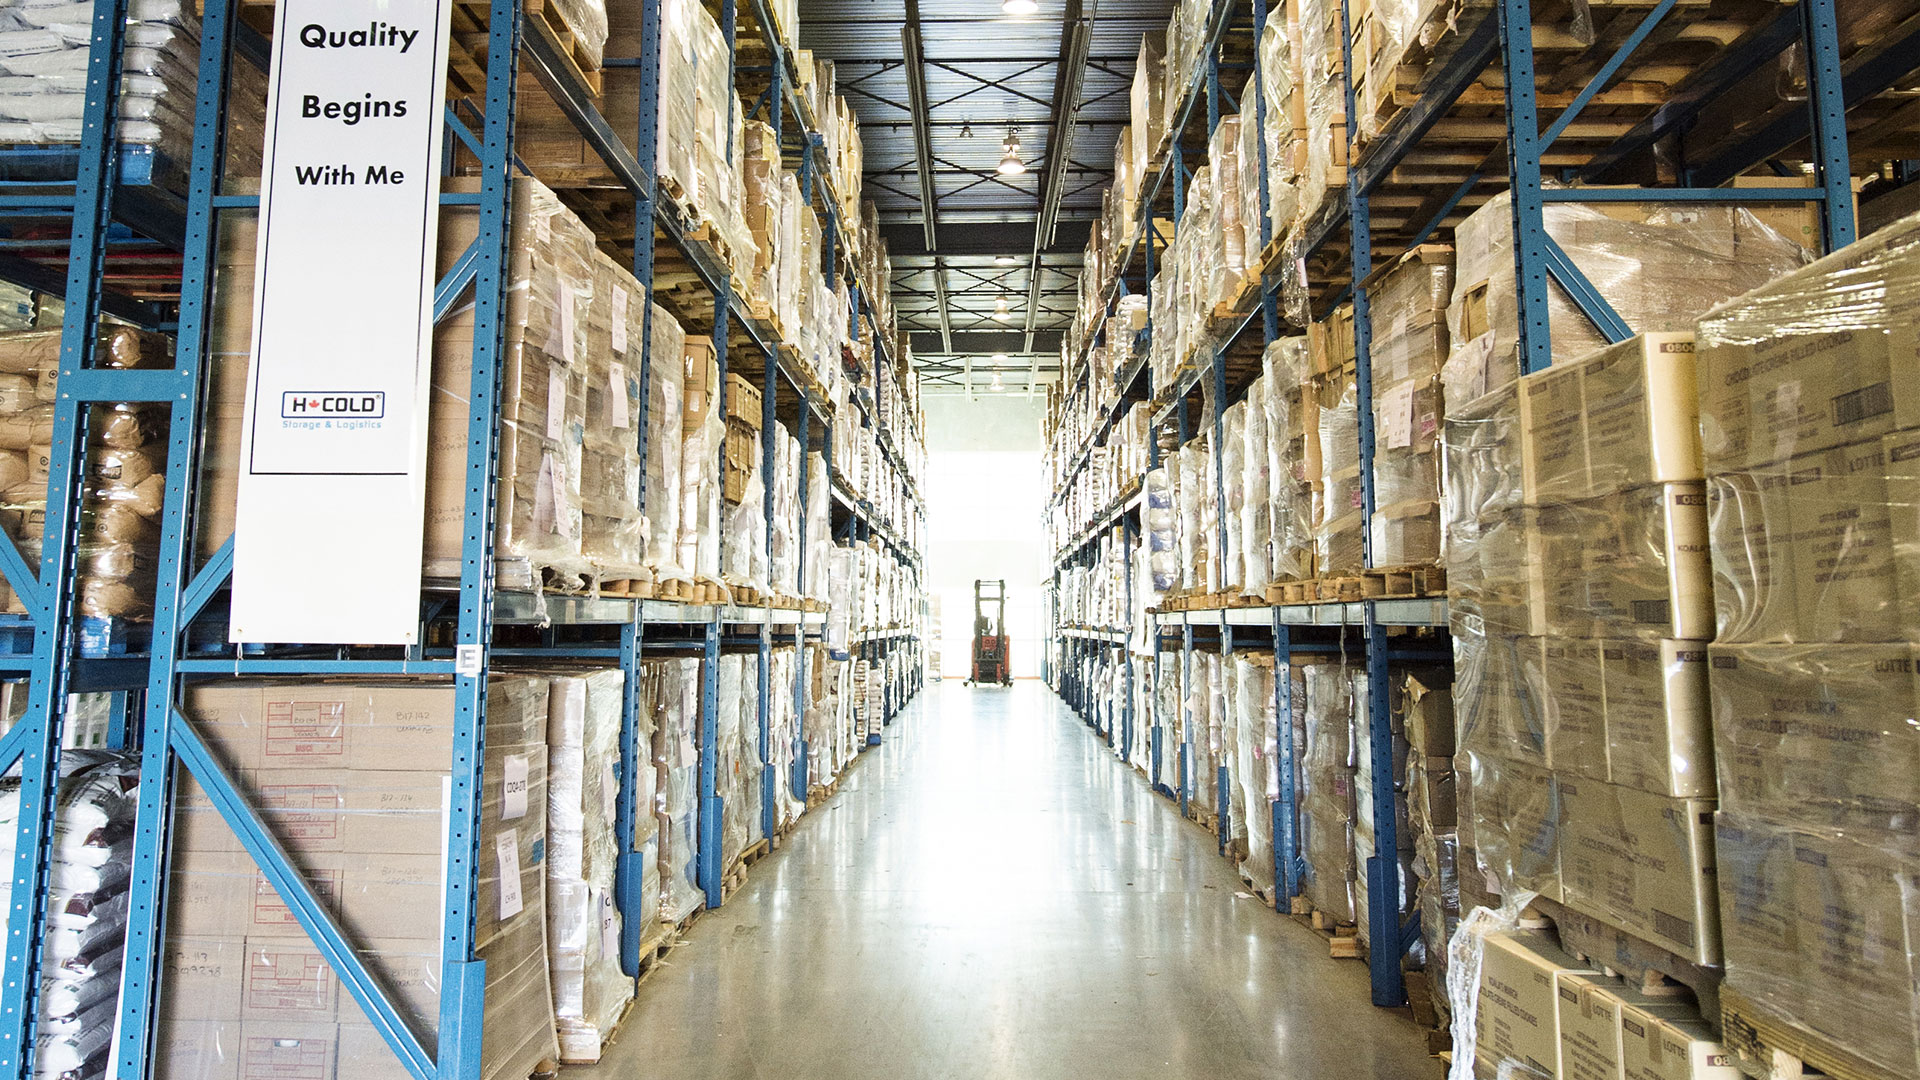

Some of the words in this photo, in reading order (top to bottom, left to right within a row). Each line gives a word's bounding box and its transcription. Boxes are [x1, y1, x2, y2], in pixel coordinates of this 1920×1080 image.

[300, 21, 419, 53] Quality
[302, 92, 407, 125] Begins
[295, 164, 355, 185] With
[364, 165, 404, 185] Me
[282, 420, 321, 430] Storage
[324, 420, 332, 428] &
[336, 421, 382, 430] Logistics
[461, 650, 475, 668] E
[1663, 1040, 1686, 1061] LOTTE
